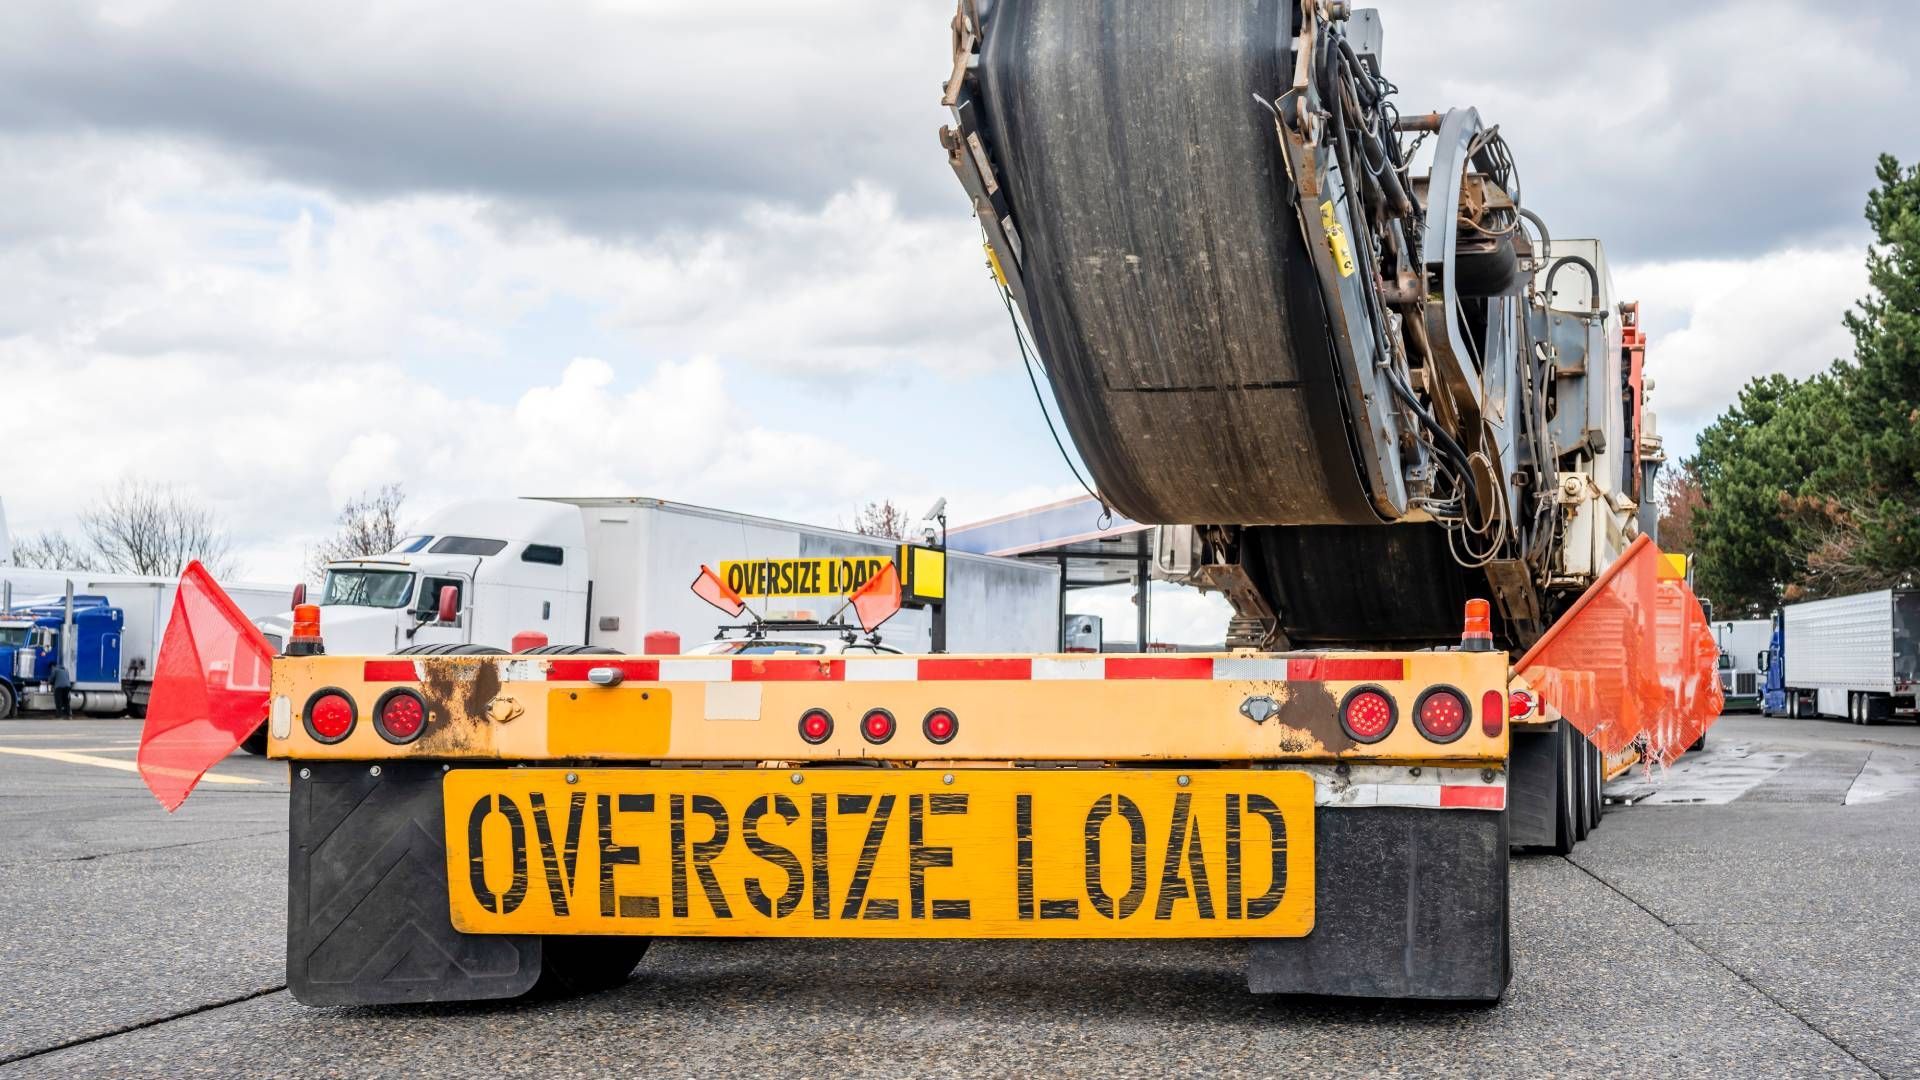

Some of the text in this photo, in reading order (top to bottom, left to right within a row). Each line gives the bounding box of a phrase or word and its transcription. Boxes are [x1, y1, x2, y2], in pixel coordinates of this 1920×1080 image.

[728, 561, 820, 594] OVERSIZE
[468, 791, 1287, 920] OVERSIZE LOAD
